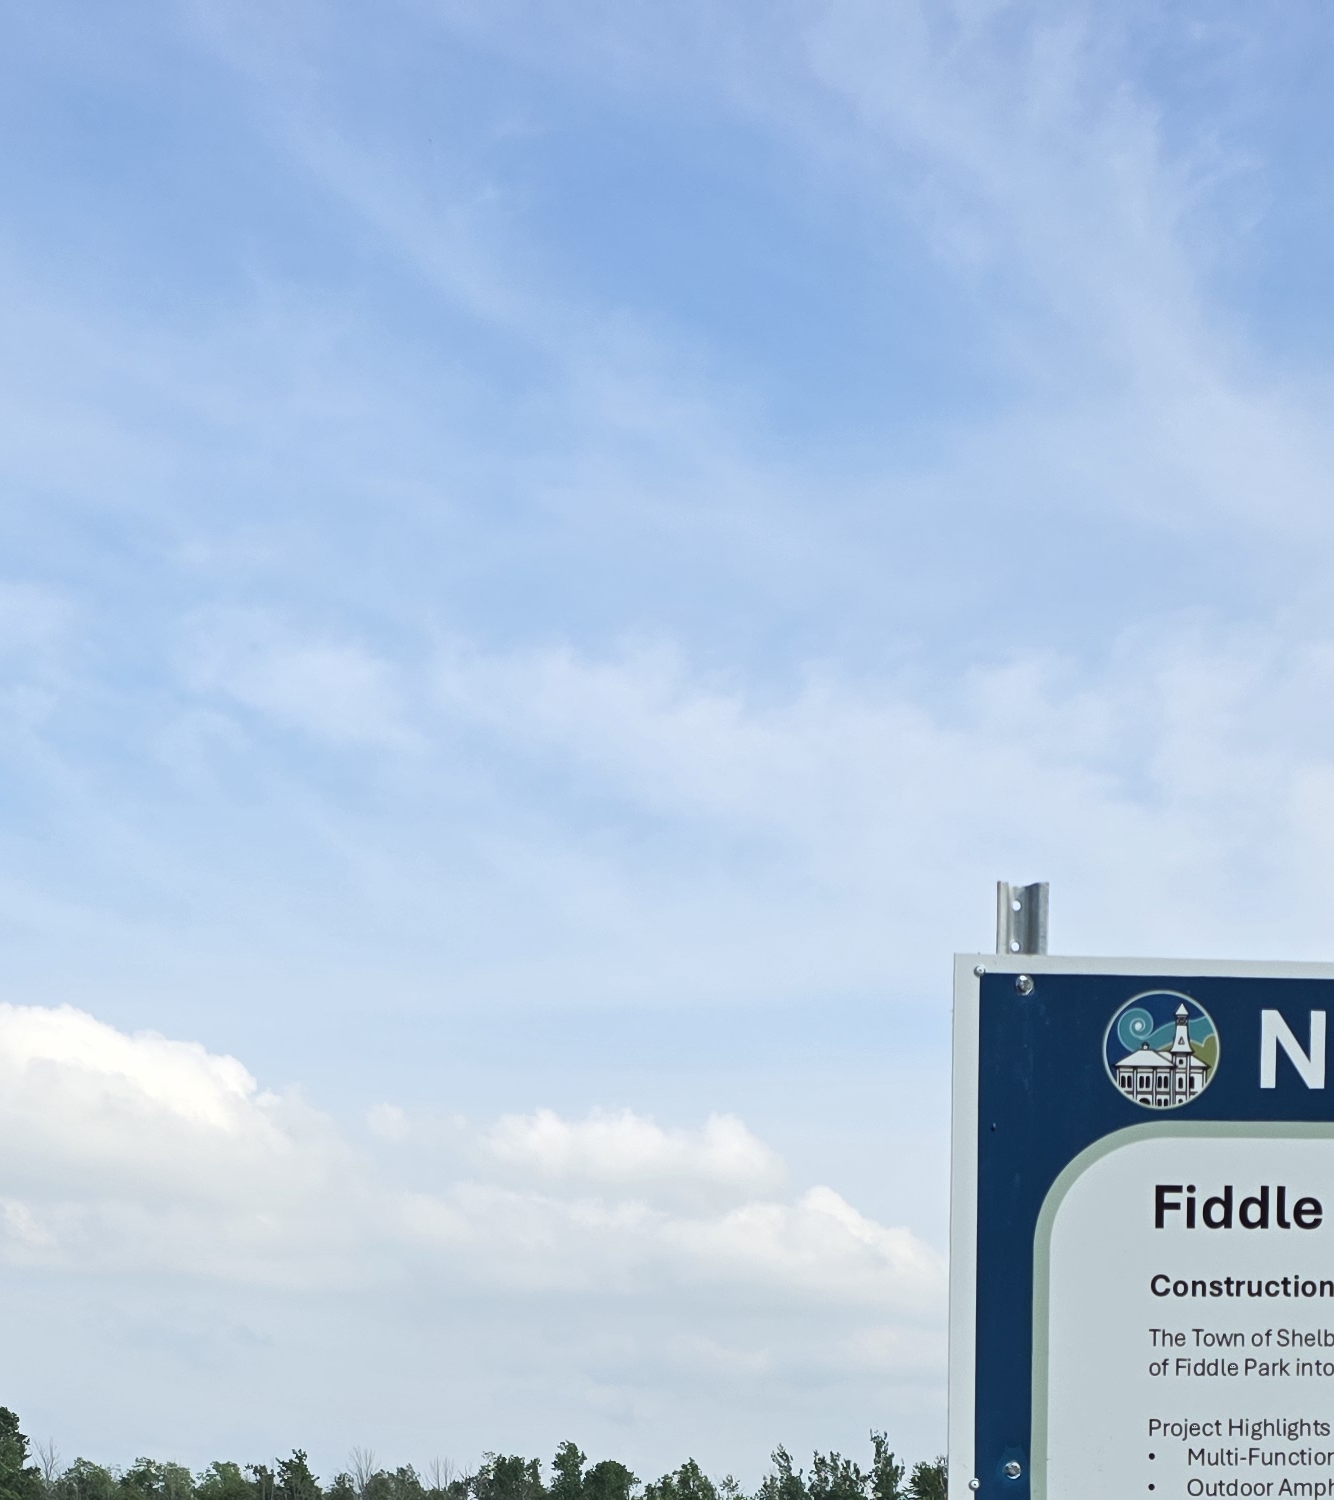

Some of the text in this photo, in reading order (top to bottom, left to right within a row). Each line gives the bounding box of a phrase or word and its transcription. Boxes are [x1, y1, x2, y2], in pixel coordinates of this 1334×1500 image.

[1154, 1184, 1323, 1230] Fiddle
[1150, 1273, 1334, 1298] Construction
[1148, 1328, 1186, 1348] The
[1191, 1328, 1245, 1348] Town
[1251, 1328, 1273, 1348] of
[1148, 1358, 1170, 1377] of
[1175, 1357, 1239, 1377] Fiddle
[1244, 1357, 1291, 1377] Park
[1148, 1418, 1223, 1442] Project
[1228, 1417, 1331, 1442] Highlights
[1186, 1478, 1275, 1497] Outdoor
